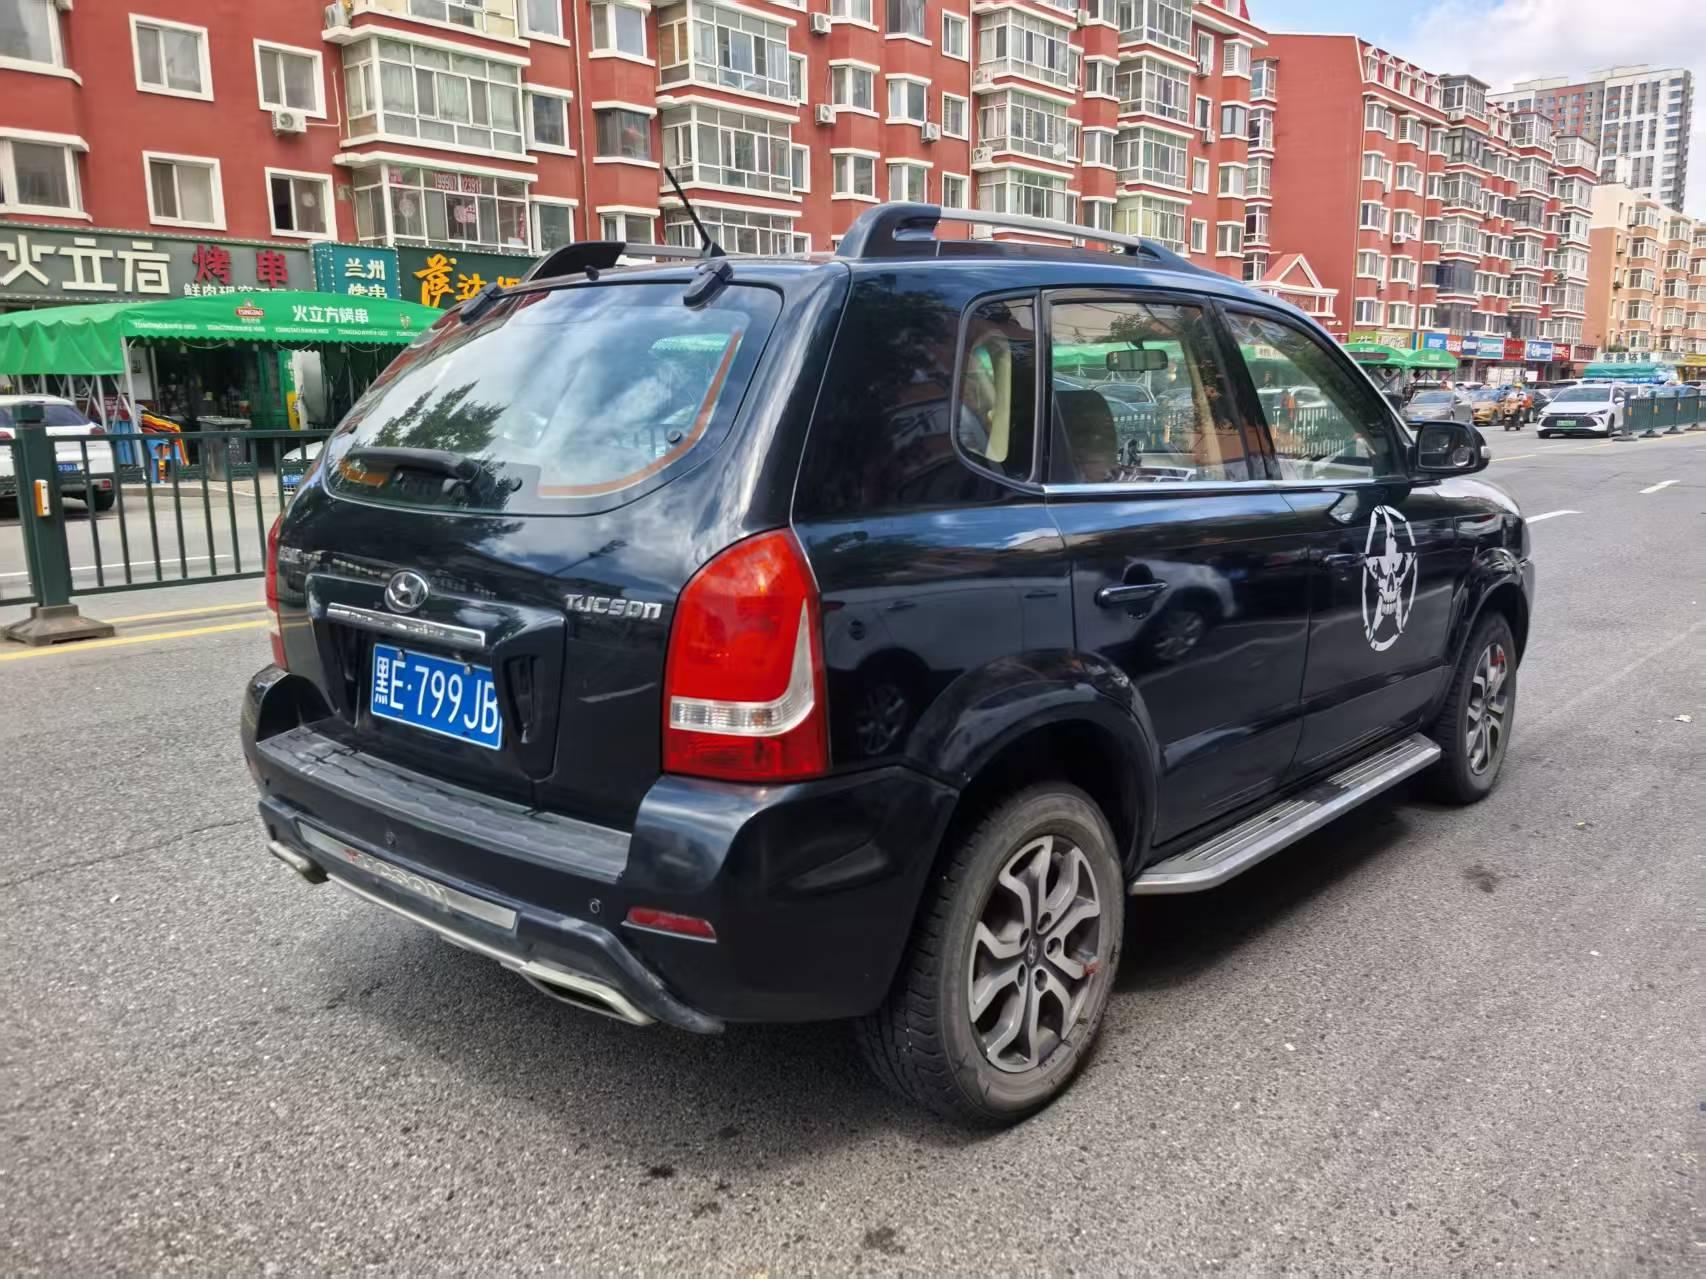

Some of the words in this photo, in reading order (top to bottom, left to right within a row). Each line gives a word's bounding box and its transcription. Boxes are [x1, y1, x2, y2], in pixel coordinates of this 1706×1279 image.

[192, 244, 289, 288] 烤串
[345, 257, 386, 280] 兰州
[292, 304, 369, 324] 火立方烤串
[564, 593, 662, 619] TUCSON
